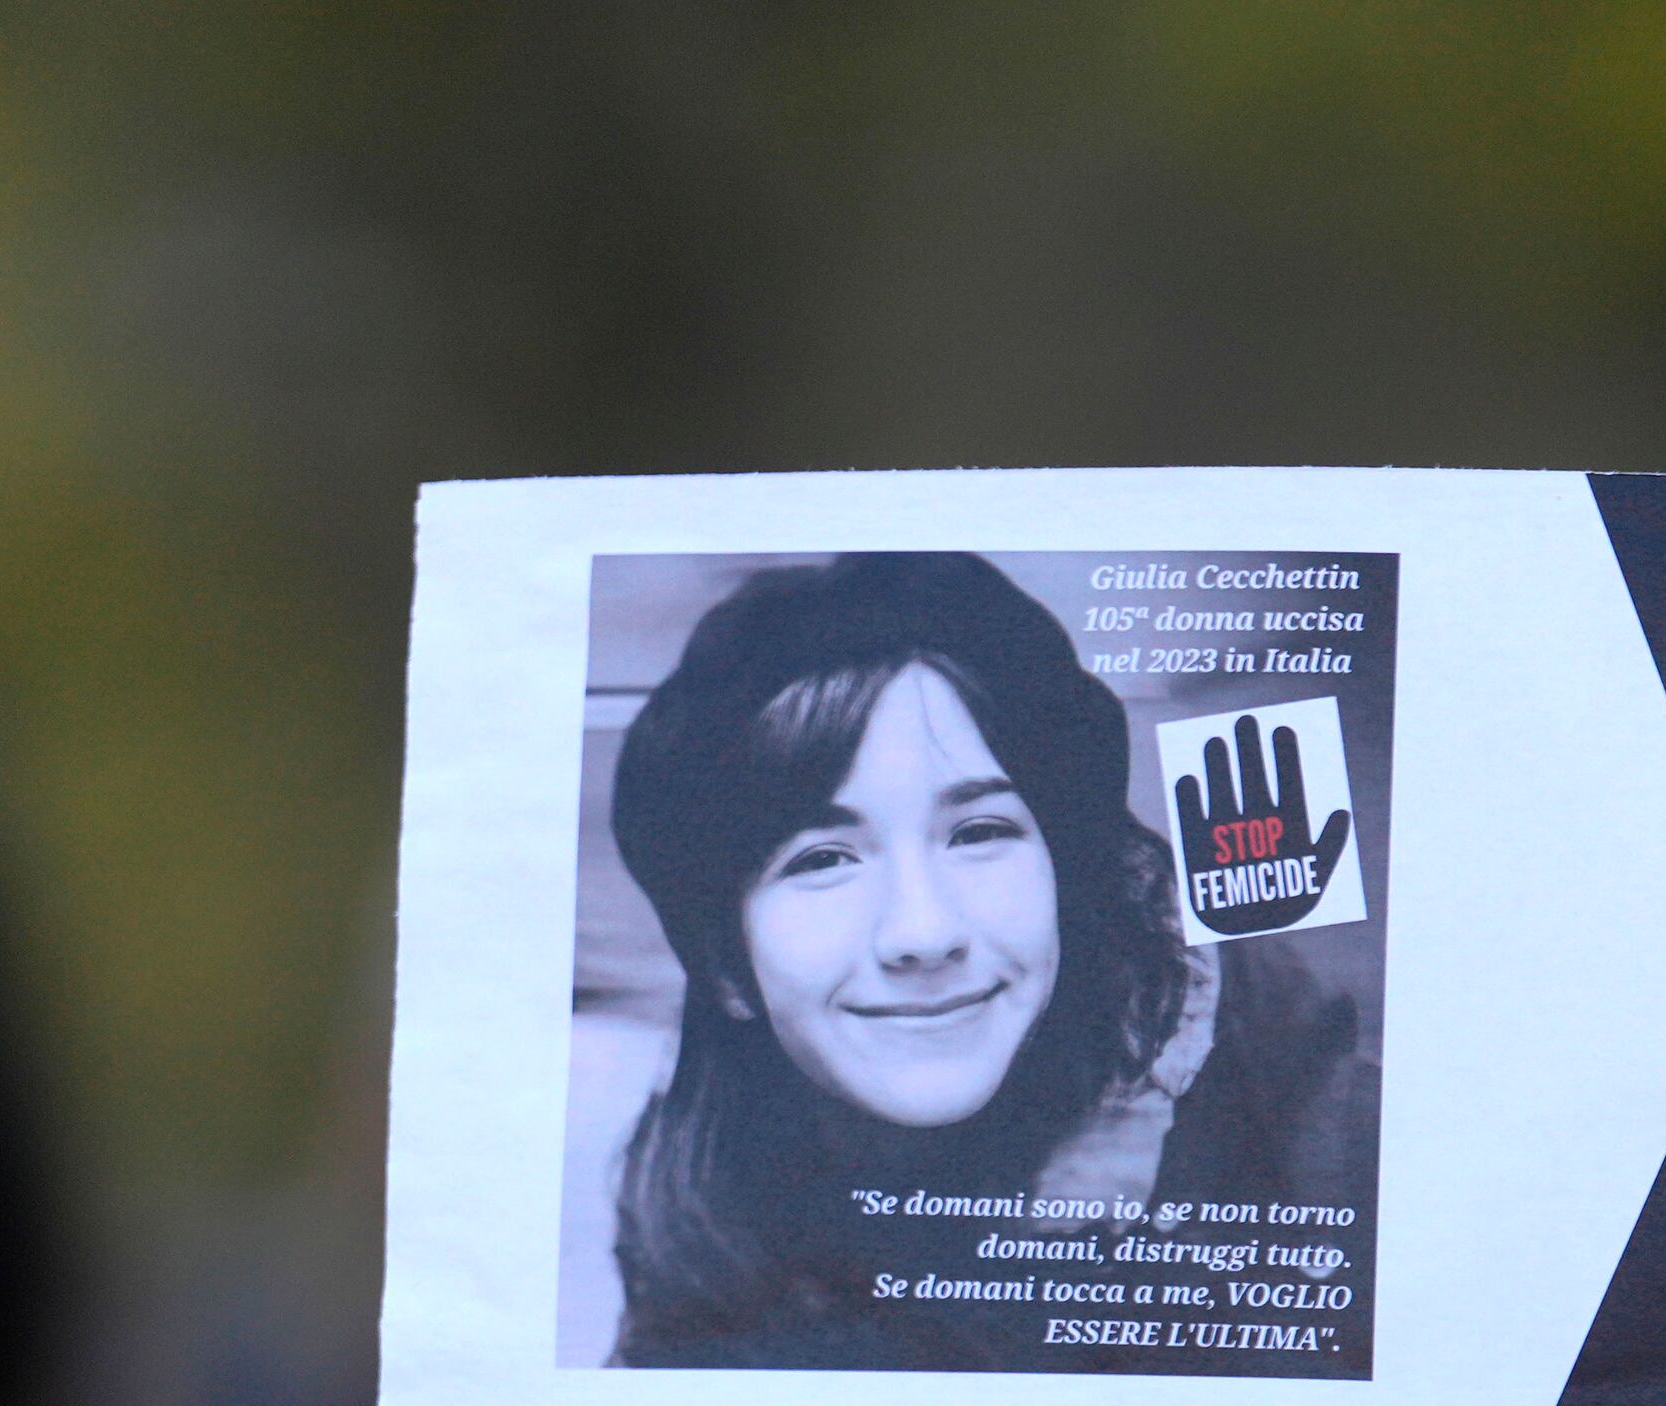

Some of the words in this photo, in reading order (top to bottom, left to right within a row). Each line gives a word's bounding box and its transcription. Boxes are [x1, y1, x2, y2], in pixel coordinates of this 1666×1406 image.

[1091, 564, 1188, 590] Giulia
[1196, 563, 1361, 590] Cecchettin
[1155, 606, 1255, 632] donna
[1263, 606, 1365, 632] uccisa
[1093, 648, 1140, 674] nel
[1148, 649, 1217, 674] 2023
[1224, 648, 1256, 674] in
[1263, 648, 1353, 674] Italia
[1212, 816, 1284, 864] STOP
[1193, 855, 1321, 912] FEMICIDE
[851, 1190, 898, 1216] "Se
[904, 1190, 1026, 1219] domani
[1032, 1197, 1106, 1220] sono
[1113, 1193, 1151, 1224] io,
[1159, 1202, 1194, 1222] se
[1200, 1203, 1261, 1224] non
[1268, 1200, 1356, 1227] torno
[978, 1233, 1105, 1265] domani,
[1115, 1236, 1259, 1271] distruggi
[1266, 1243, 1353, 1268] tutto.
[873, 1273, 908, 1299] Se
[915, 1274, 1036, 1302] domani
[1043, 1277, 1126, 1304] tocca
[1134, 1285, 1154, 1305] a
[1162, 1286, 1217, 1312] me,
[1229, 1282, 1353, 1310] VOGLIO
[1045, 1319, 1162, 1346] ESSERE
[1167, 1323, 1342, 1352] L'ULTIMA".
